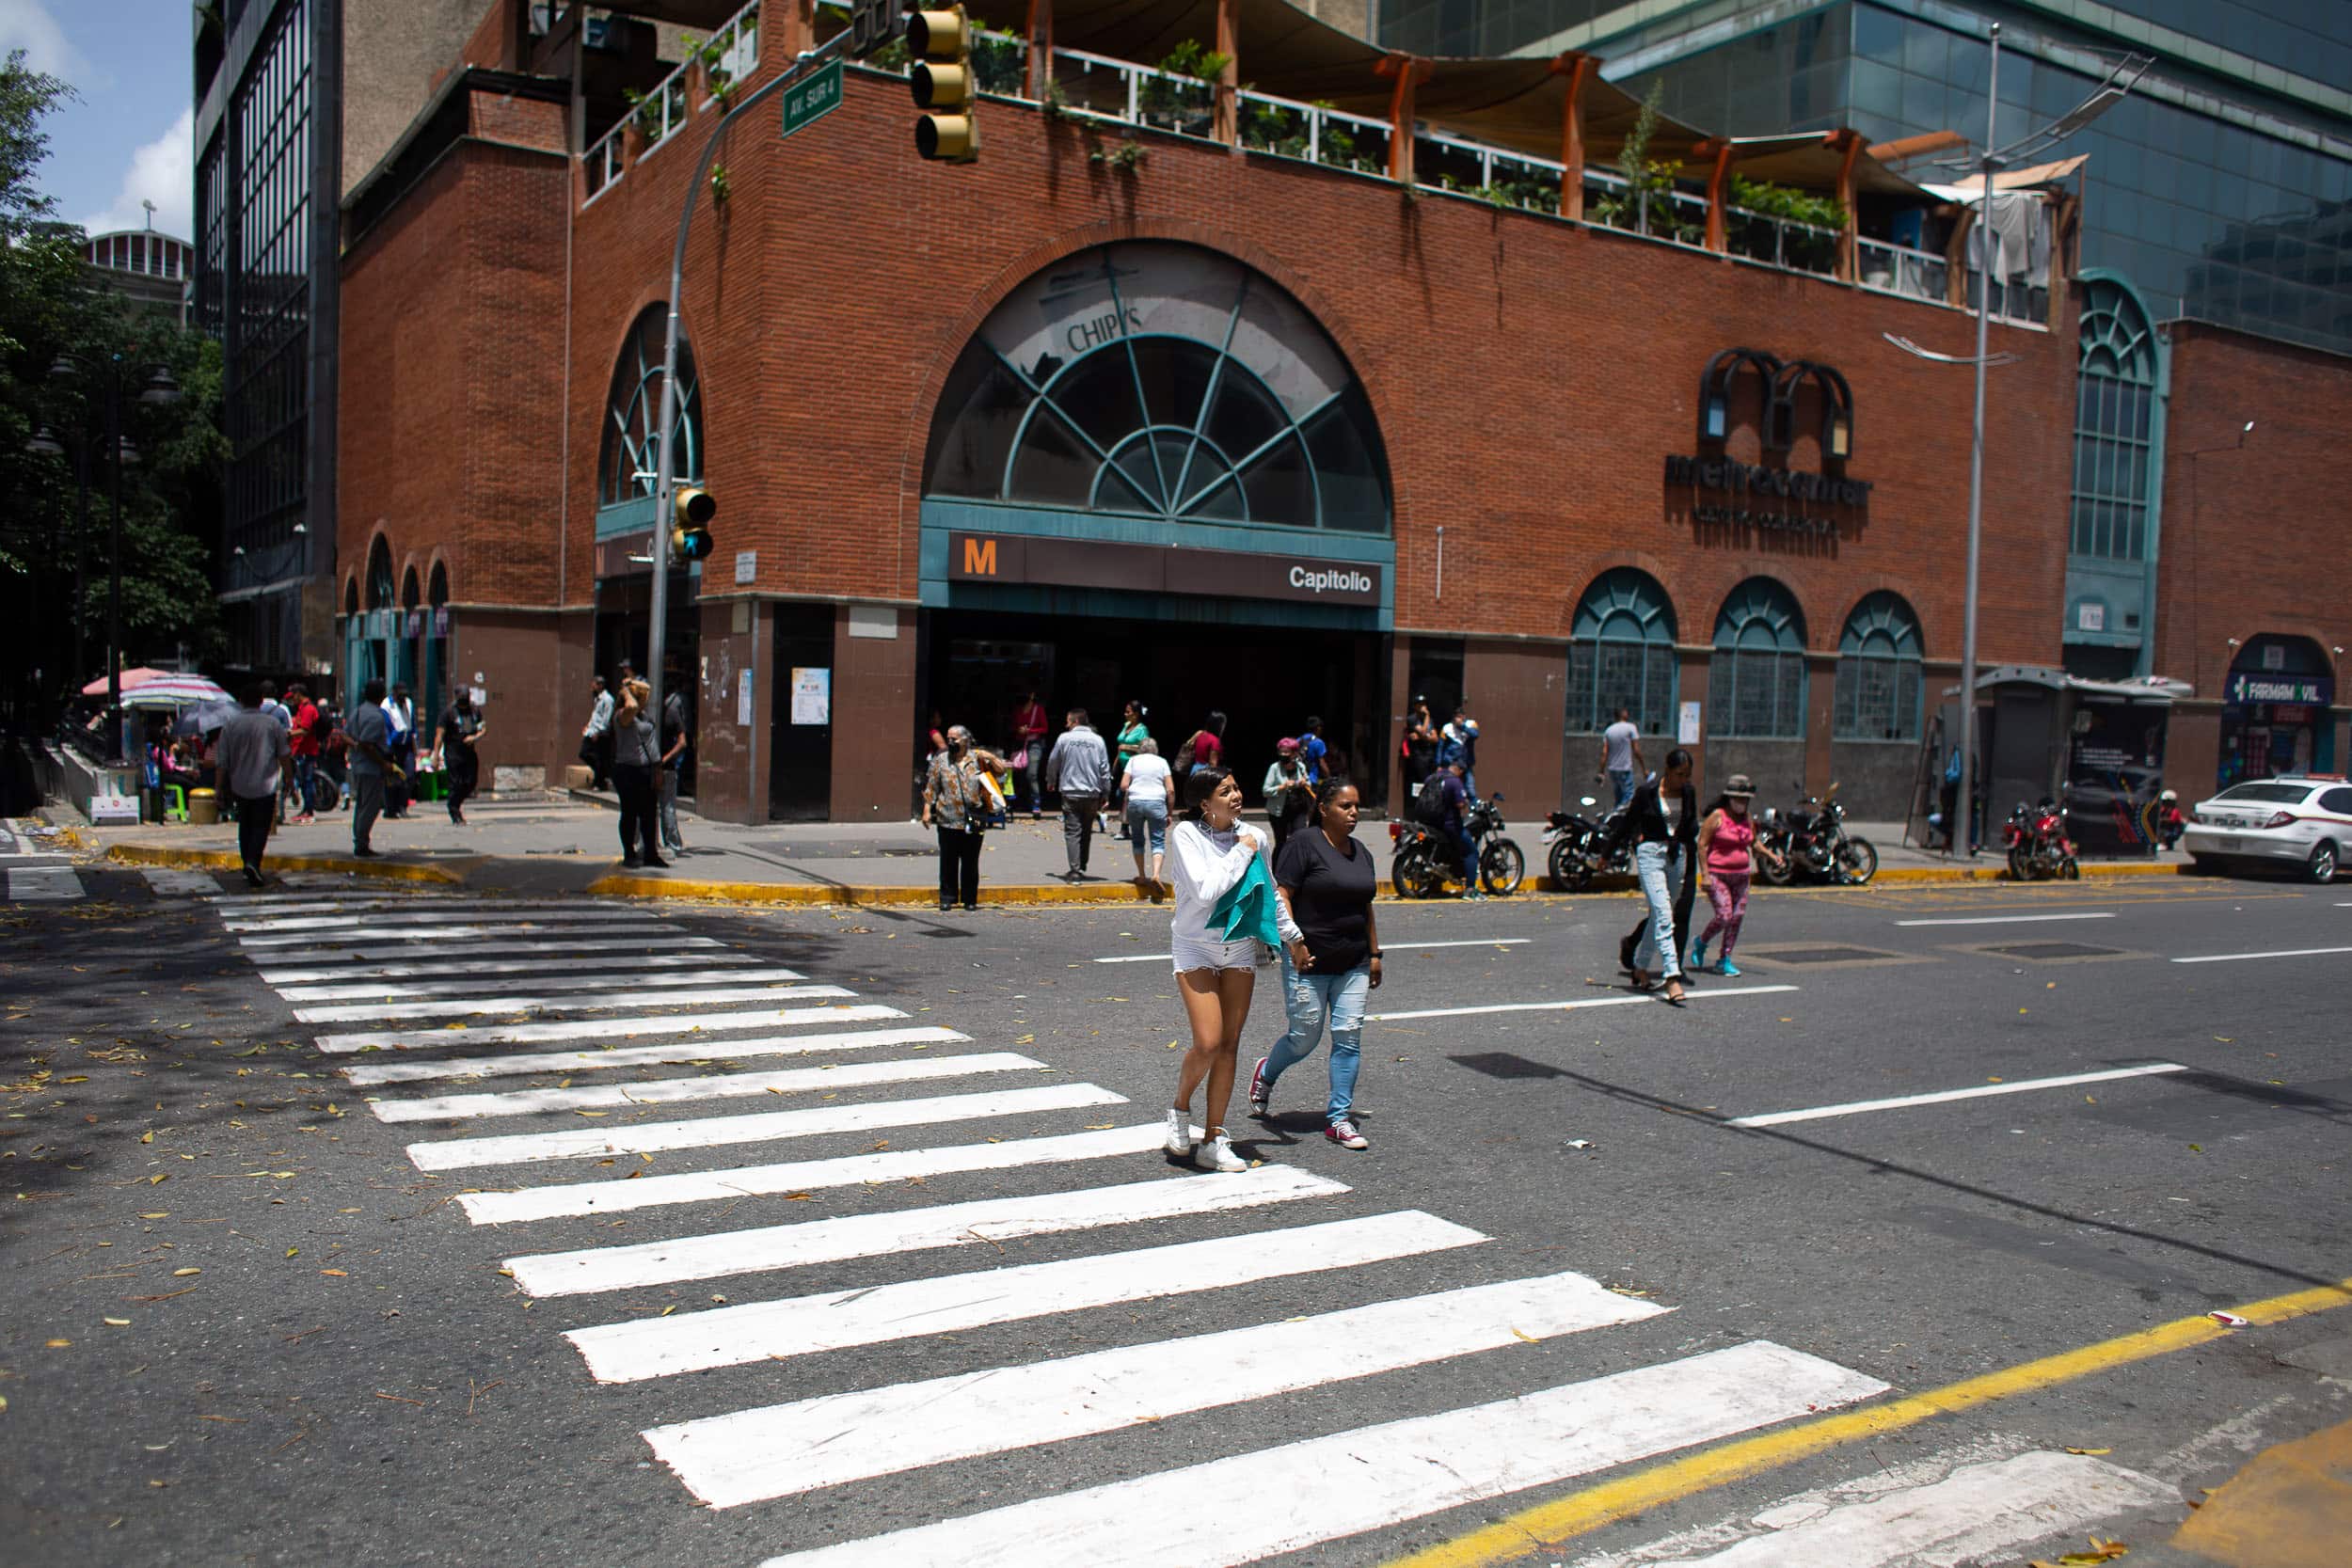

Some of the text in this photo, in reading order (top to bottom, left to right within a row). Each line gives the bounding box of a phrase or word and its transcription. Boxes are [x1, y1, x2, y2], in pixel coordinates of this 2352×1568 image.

[806, 82, 827, 108] SUR
[828, 77, 834, 93] 4
[964, 538, 996, 575] M
[1289, 565, 1372, 593] Capitolio
